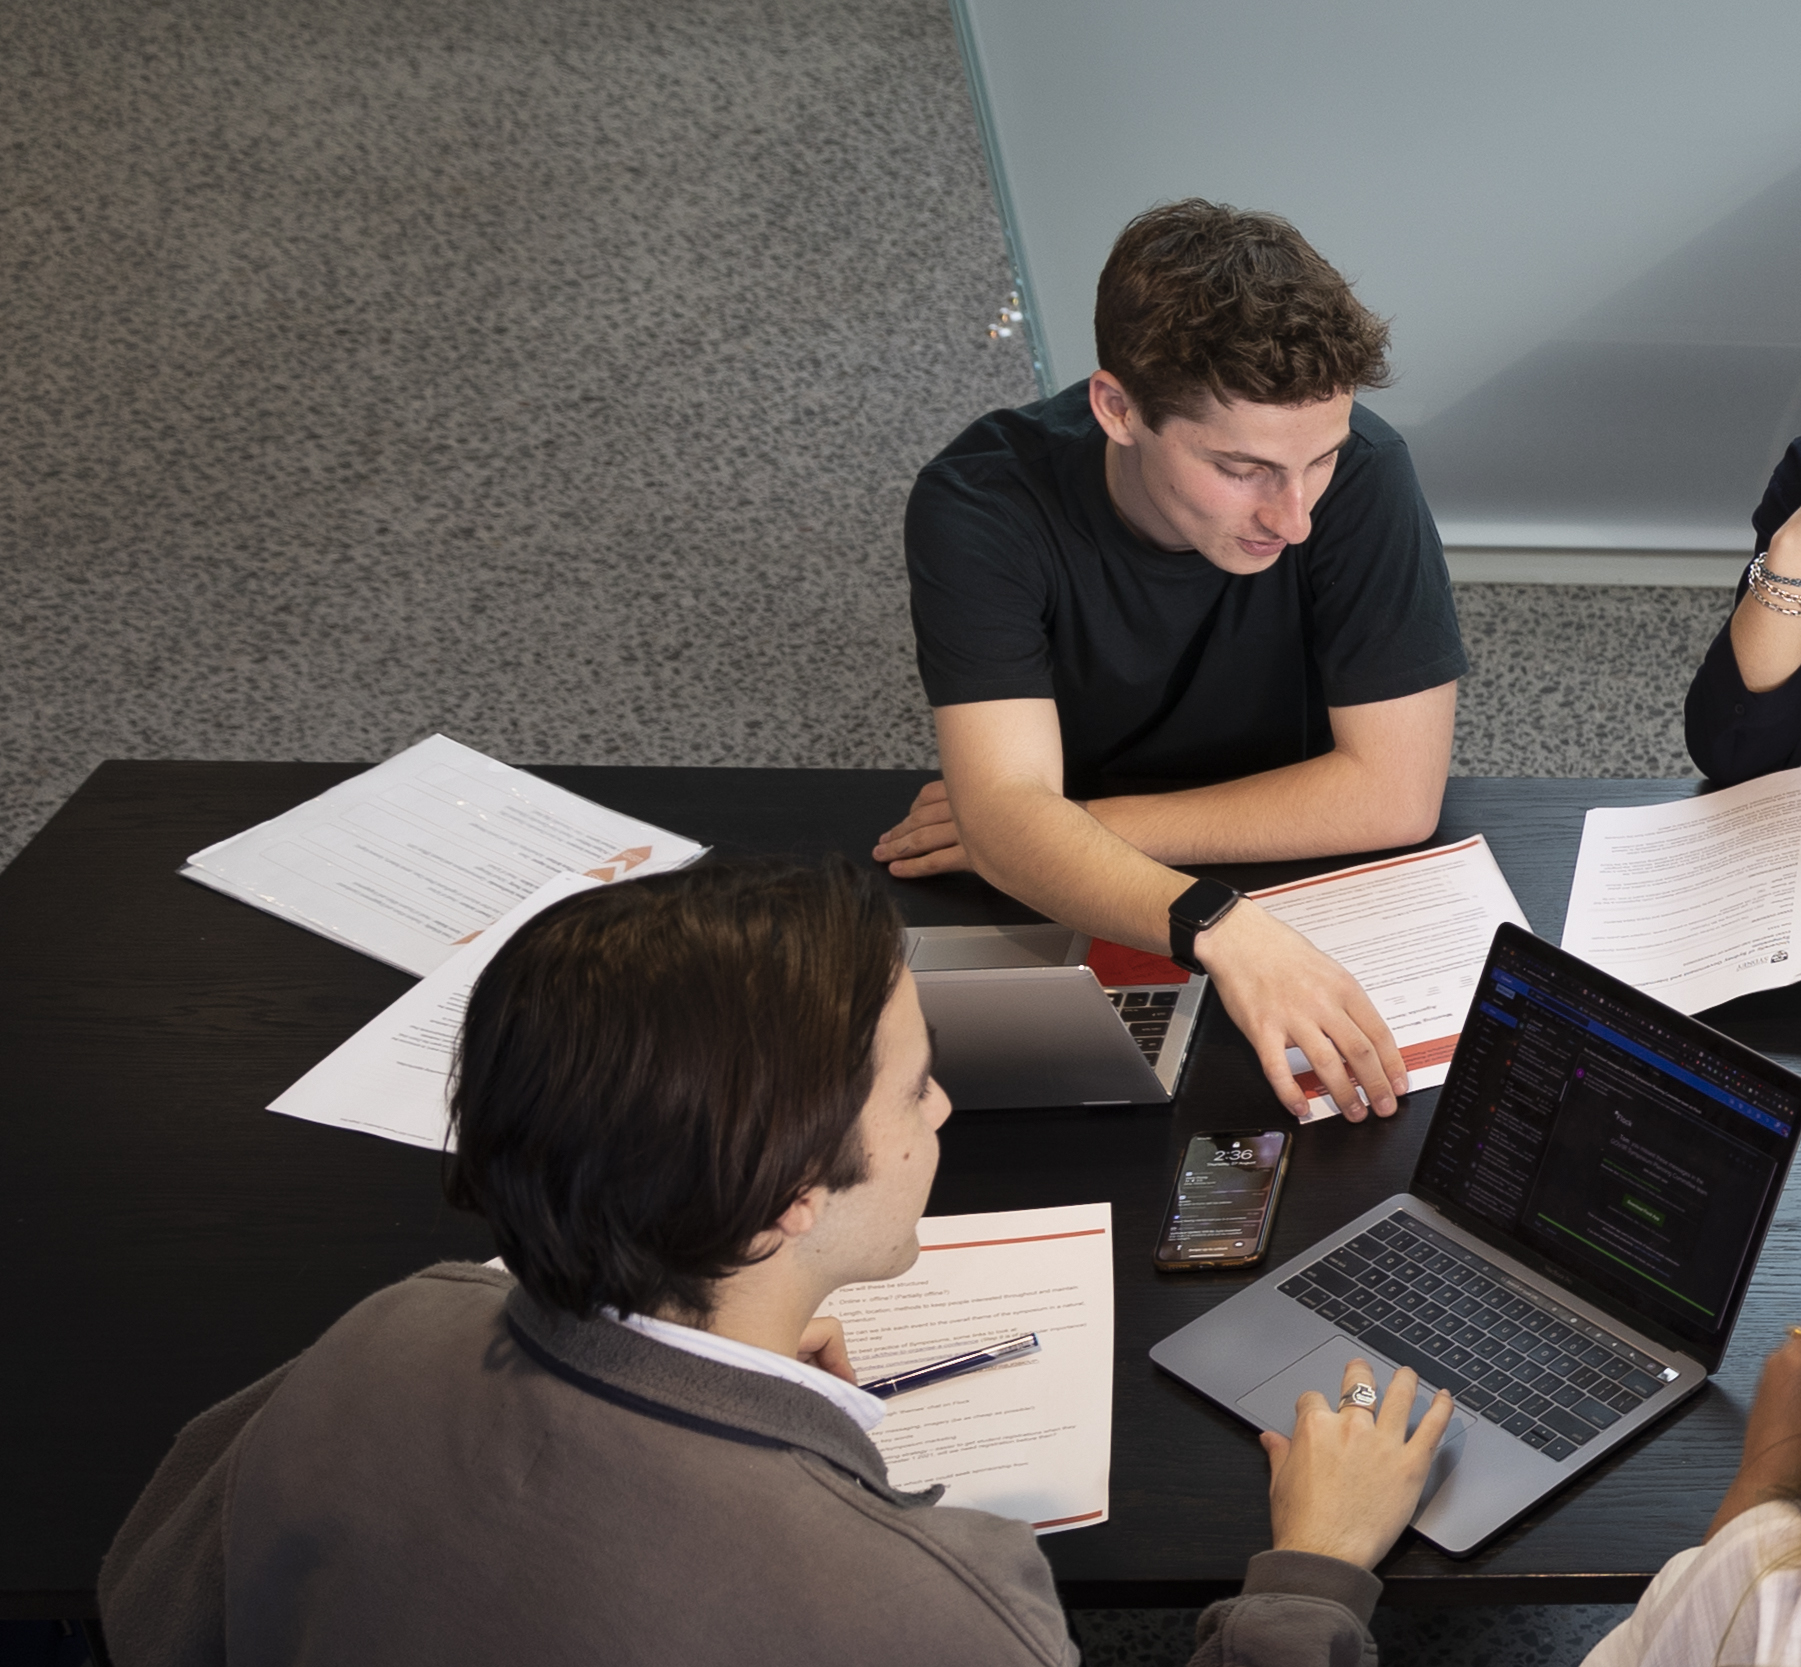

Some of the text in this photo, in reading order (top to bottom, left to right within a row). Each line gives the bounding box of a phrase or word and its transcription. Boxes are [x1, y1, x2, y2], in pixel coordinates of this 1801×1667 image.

[1213, 1149, 1253, 1162] 2:36
[839, 1285, 854, 1293] How
[896, 1279, 929, 1288] structured
[893, 1304, 922, 1312] methods
[947, 1299, 970, 1307] people
[970, 1294, 1003, 1303] interested
[1002, 1290, 1038, 1299] throughout
[948, 1316, 971, 1324] overall
[1012, 1306, 1048, 1315] symposium
